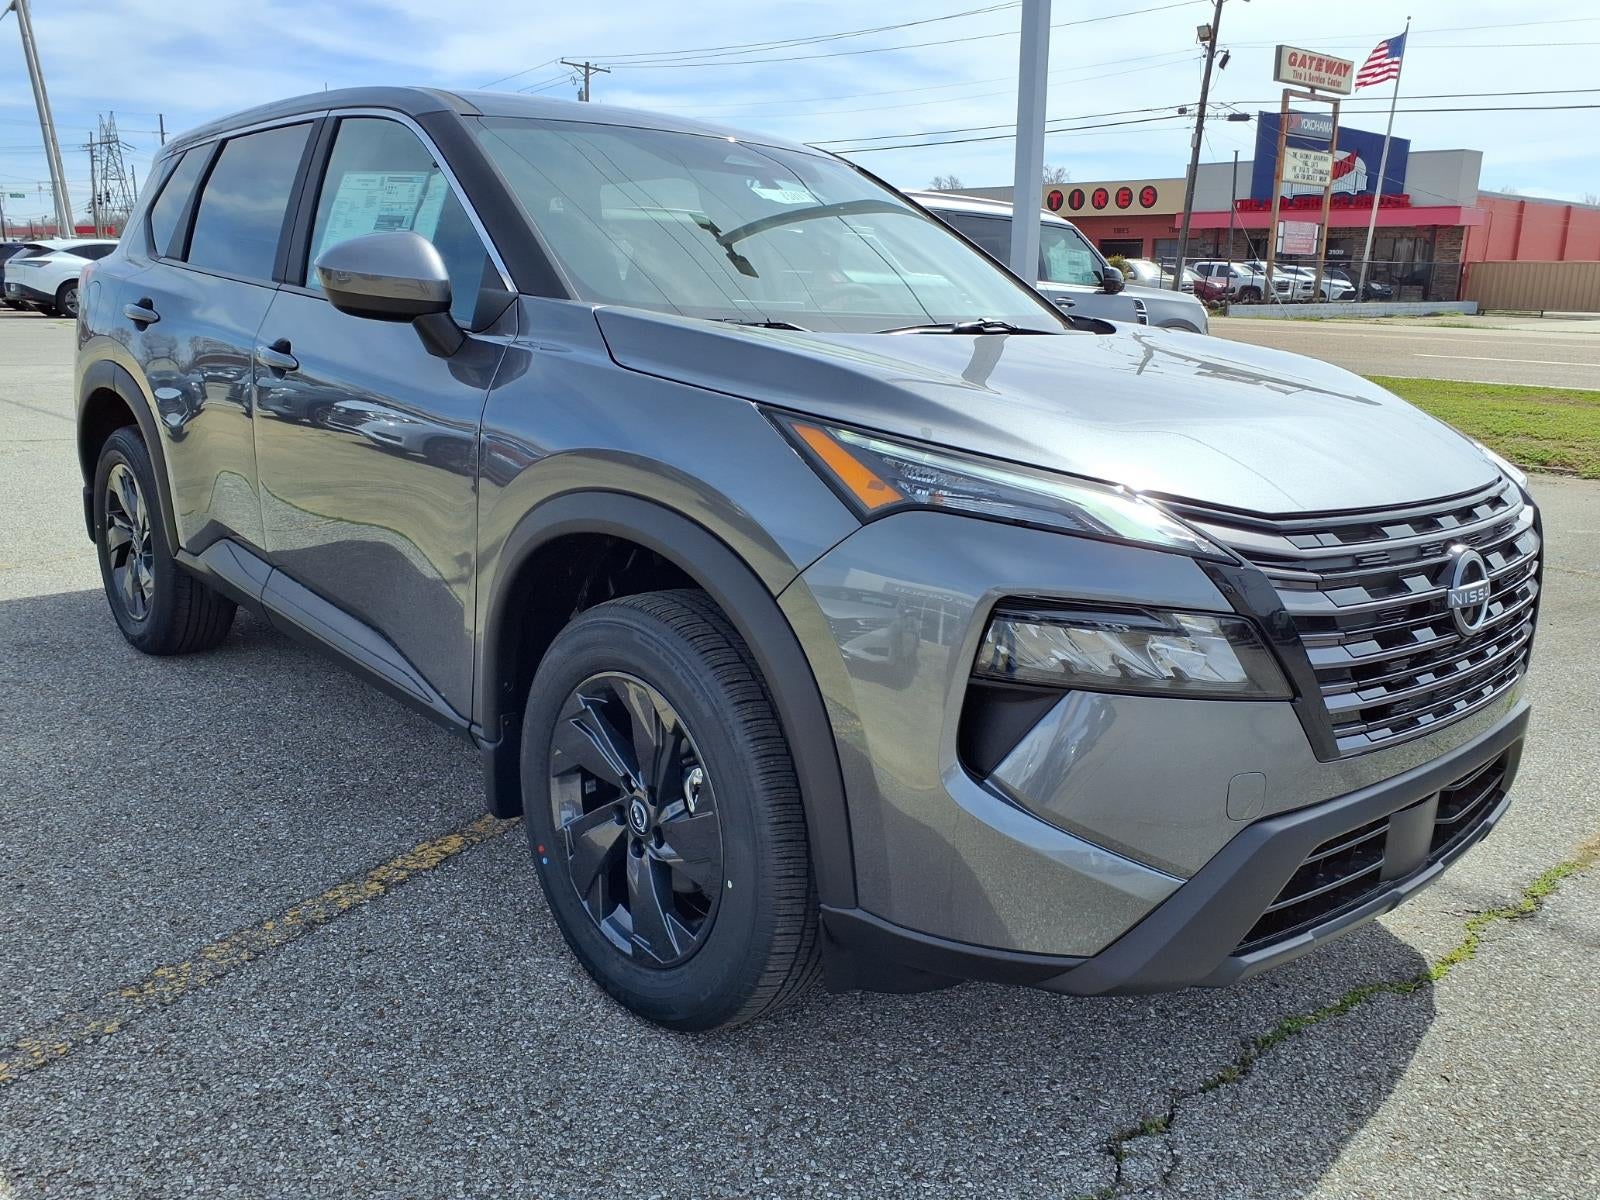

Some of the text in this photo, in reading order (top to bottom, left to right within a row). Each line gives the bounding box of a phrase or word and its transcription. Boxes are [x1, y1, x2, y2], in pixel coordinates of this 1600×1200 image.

[1288, 51, 1351, 78] GATEWAY
[1292, 70, 1302, 81] Tire
[1308, 72, 1326, 84] Service
[1327, 77, 1342, 88] Center
[1301, 117, 1333, 134] YOKOHAMA
[1048, 188, 1155, 209] TIRES
[1113, 226, 1130, 234] TIRES
